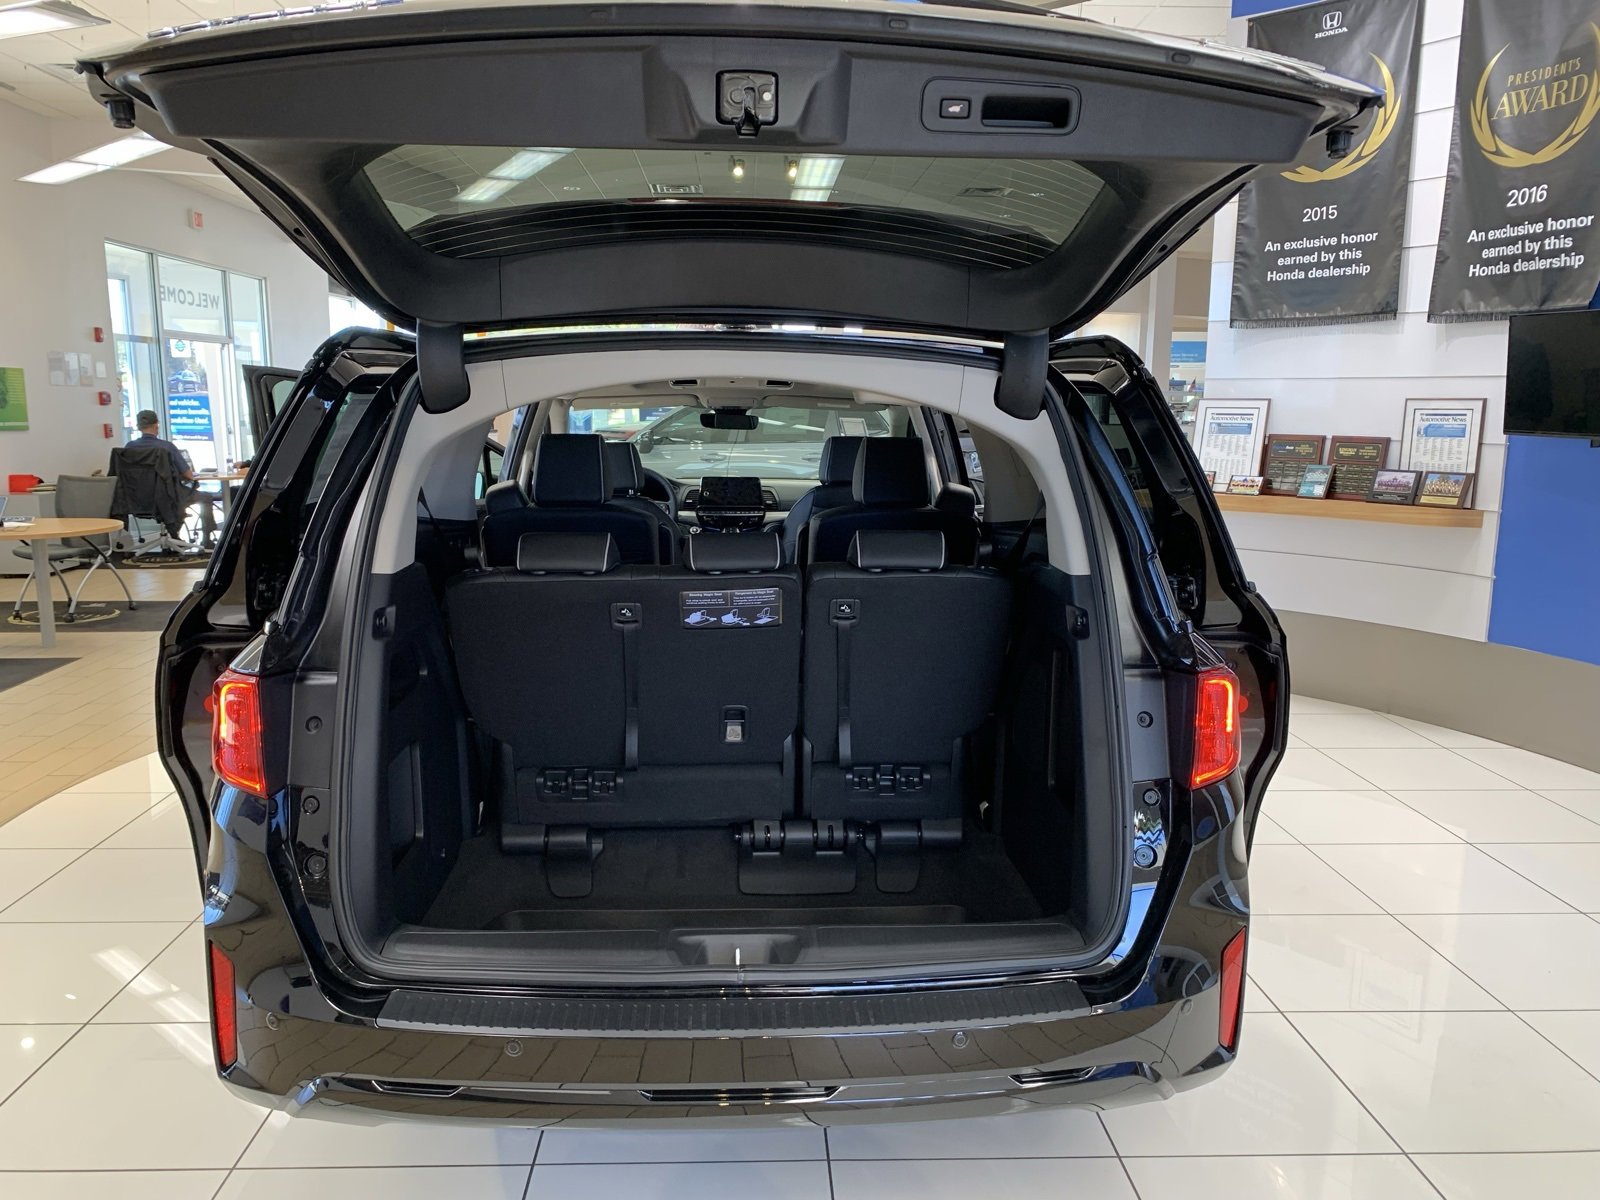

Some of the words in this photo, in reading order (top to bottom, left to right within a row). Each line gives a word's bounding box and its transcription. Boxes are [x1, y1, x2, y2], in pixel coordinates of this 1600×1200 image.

[1315, 27, 1348, 39] HONDA
[1507, 57, 1581, 87] PRESIDENT'S
[1491, 73, 1589, 120] AWARD
[1506, 184, 1548, 207] 2016
[1302, 205, 1338, 222] 2015
[1467, 230, 1485, 243] An
[1488, 221, 1544, 240] exclusive
[1547, 215, 1594, 231] honor
[1264, 241, 1280, 252] An
[1284, 236, 1338, 250] exclusive
[1341, 232, 1378, 244] honor
[1482, 241, 1521, 258] earned
[1525, 240, 1541, 254] by
[1544, 235, 1573, 250] this
[1277, 252, 1317, 266] earned
[1321, 251, 1336, 263] by
[1339, 248, 1363, 260] this
[1469, 261, 1510, 277] Honda
[1513, 252, 1584, 272] dealership
[1267, 269, 1305, 281] Honda
[1308, 263, 1371, 279] dealership
